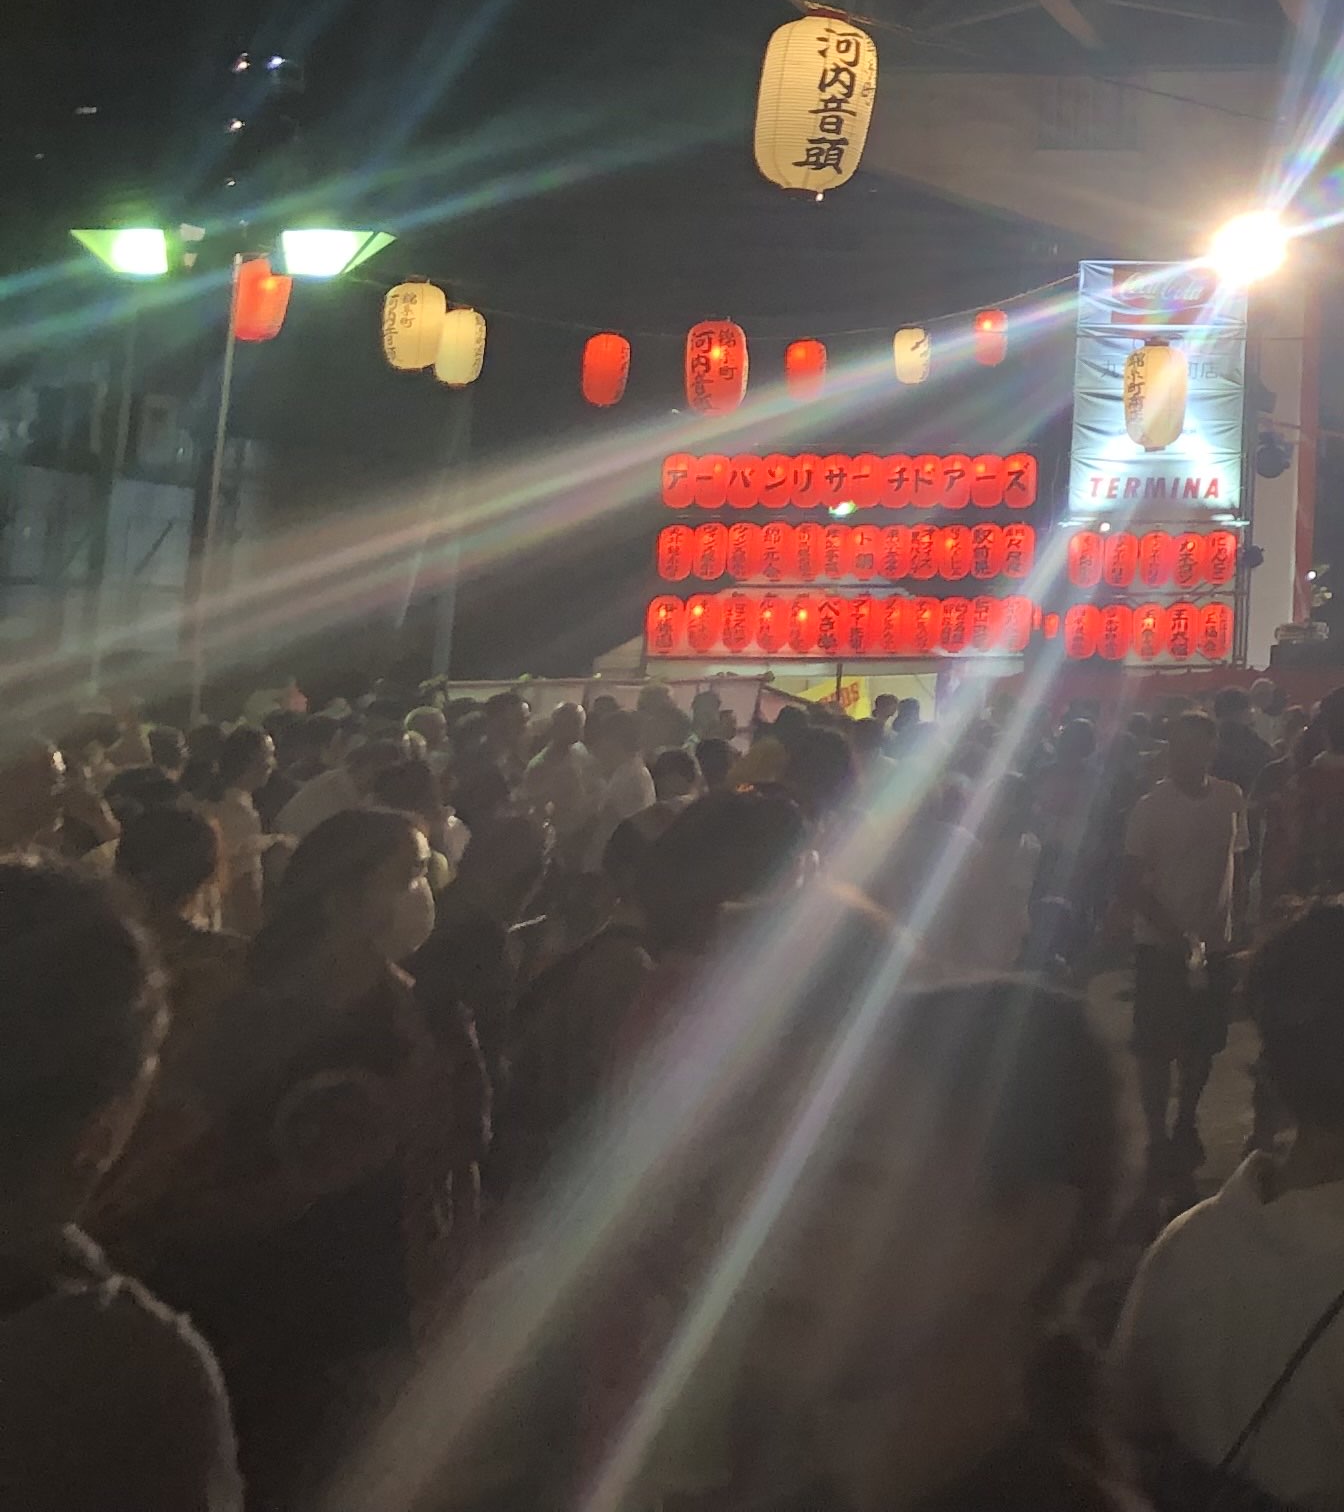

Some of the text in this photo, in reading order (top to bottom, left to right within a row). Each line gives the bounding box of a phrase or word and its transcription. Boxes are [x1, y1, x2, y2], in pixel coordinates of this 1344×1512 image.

[791, 27, 864, 175] 河内音頭
[1090, 476, 1220, 501] TERMINA
